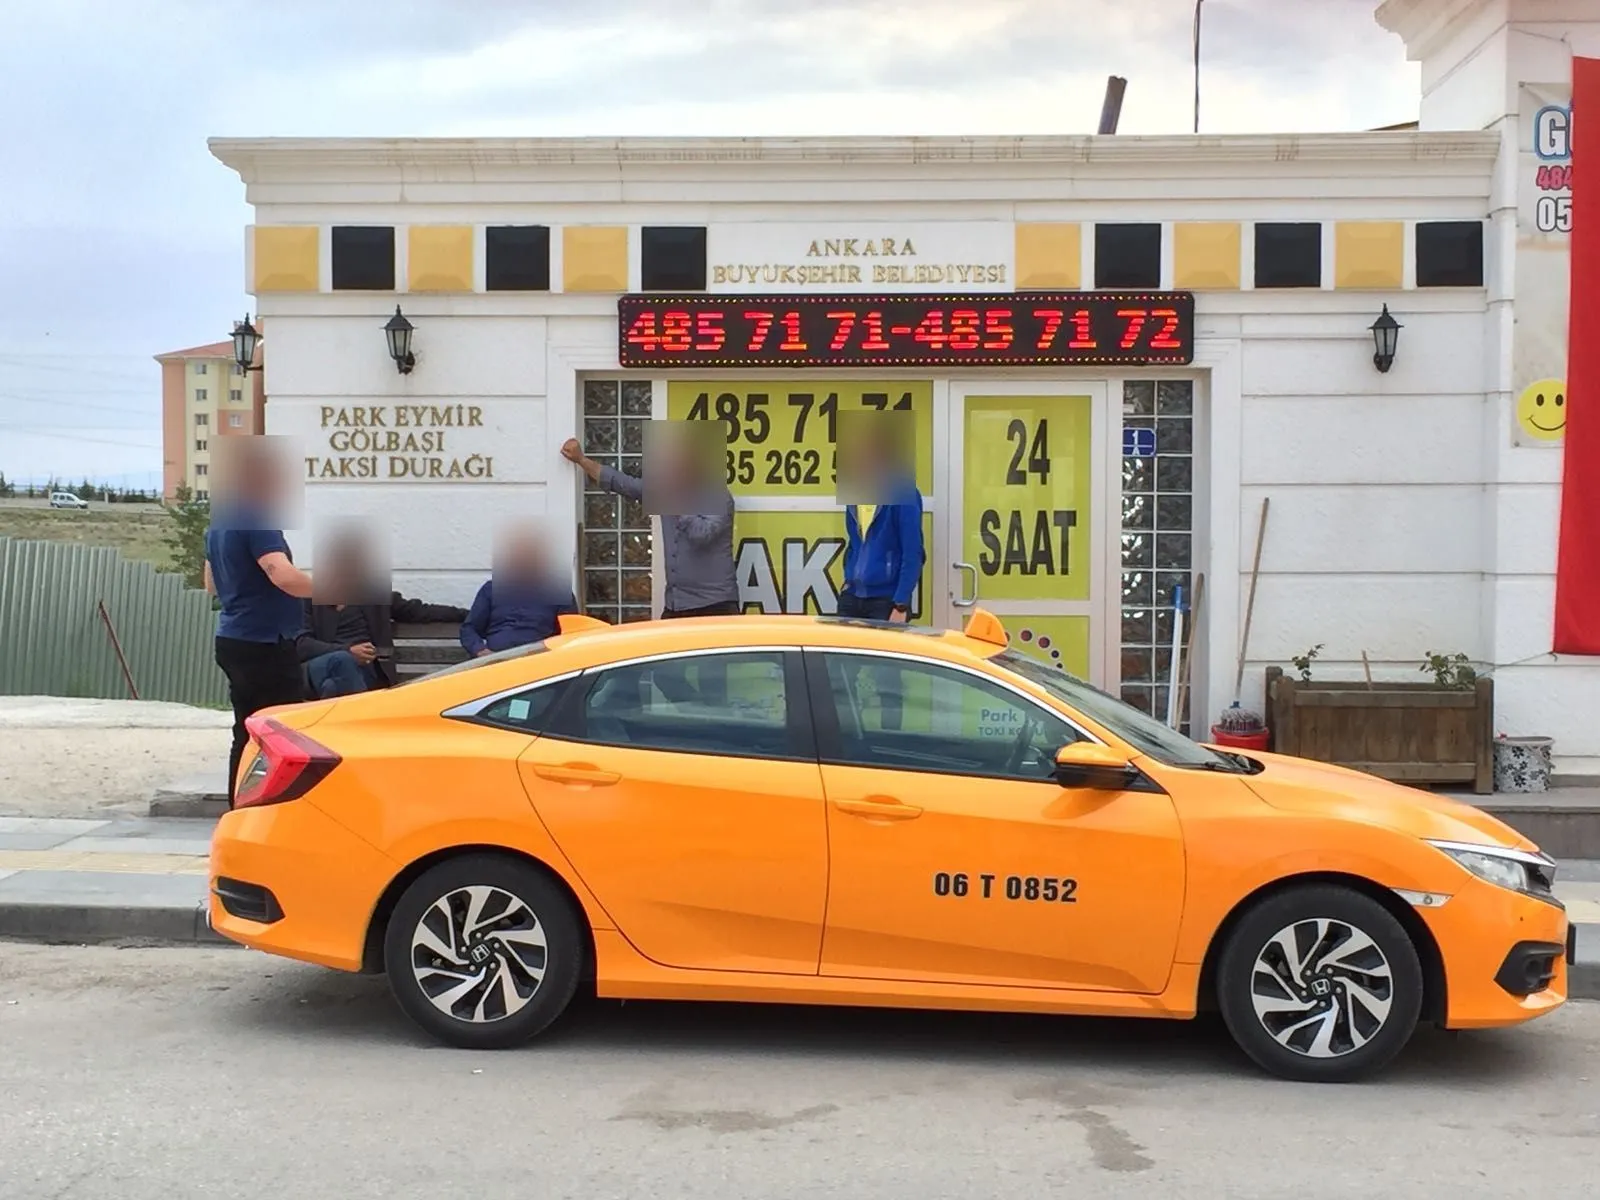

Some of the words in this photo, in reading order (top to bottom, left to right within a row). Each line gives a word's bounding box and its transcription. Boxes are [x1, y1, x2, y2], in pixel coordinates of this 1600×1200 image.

[1535, 104, 1573, 160] G
[1537, 196, 1573, 232] 05
[806, 238, 917, 257] ANKARA
[627, 311, 726, 351] 485
[743, 311, 807, 351] 71
[1033, 309, 1097, 349] 71
[1116, 309, 1181, 349] 72
[320, 406, 386, 428] PARK
[394, 404, 484, 428] EYMİR
[788, 392, 838, 443] 71
[329, 429, 445, 454] GÖLBAŞI
[1006, 418, 1051, 486] 24
[1132, 430, 1139, 445] 1
[304, 455, 379, 478] TAKSİ
[389, 453, 494, 479] DURAĞI
[765, 449, 820, 485] 262
[978, 508, 1078, 577] SAAT
[981, 708, 1018, 722] Park
[935, 872, 969, 897] 06
[980, 874, 996, 898] T
[1006, 876, 1078, 903] 0852
